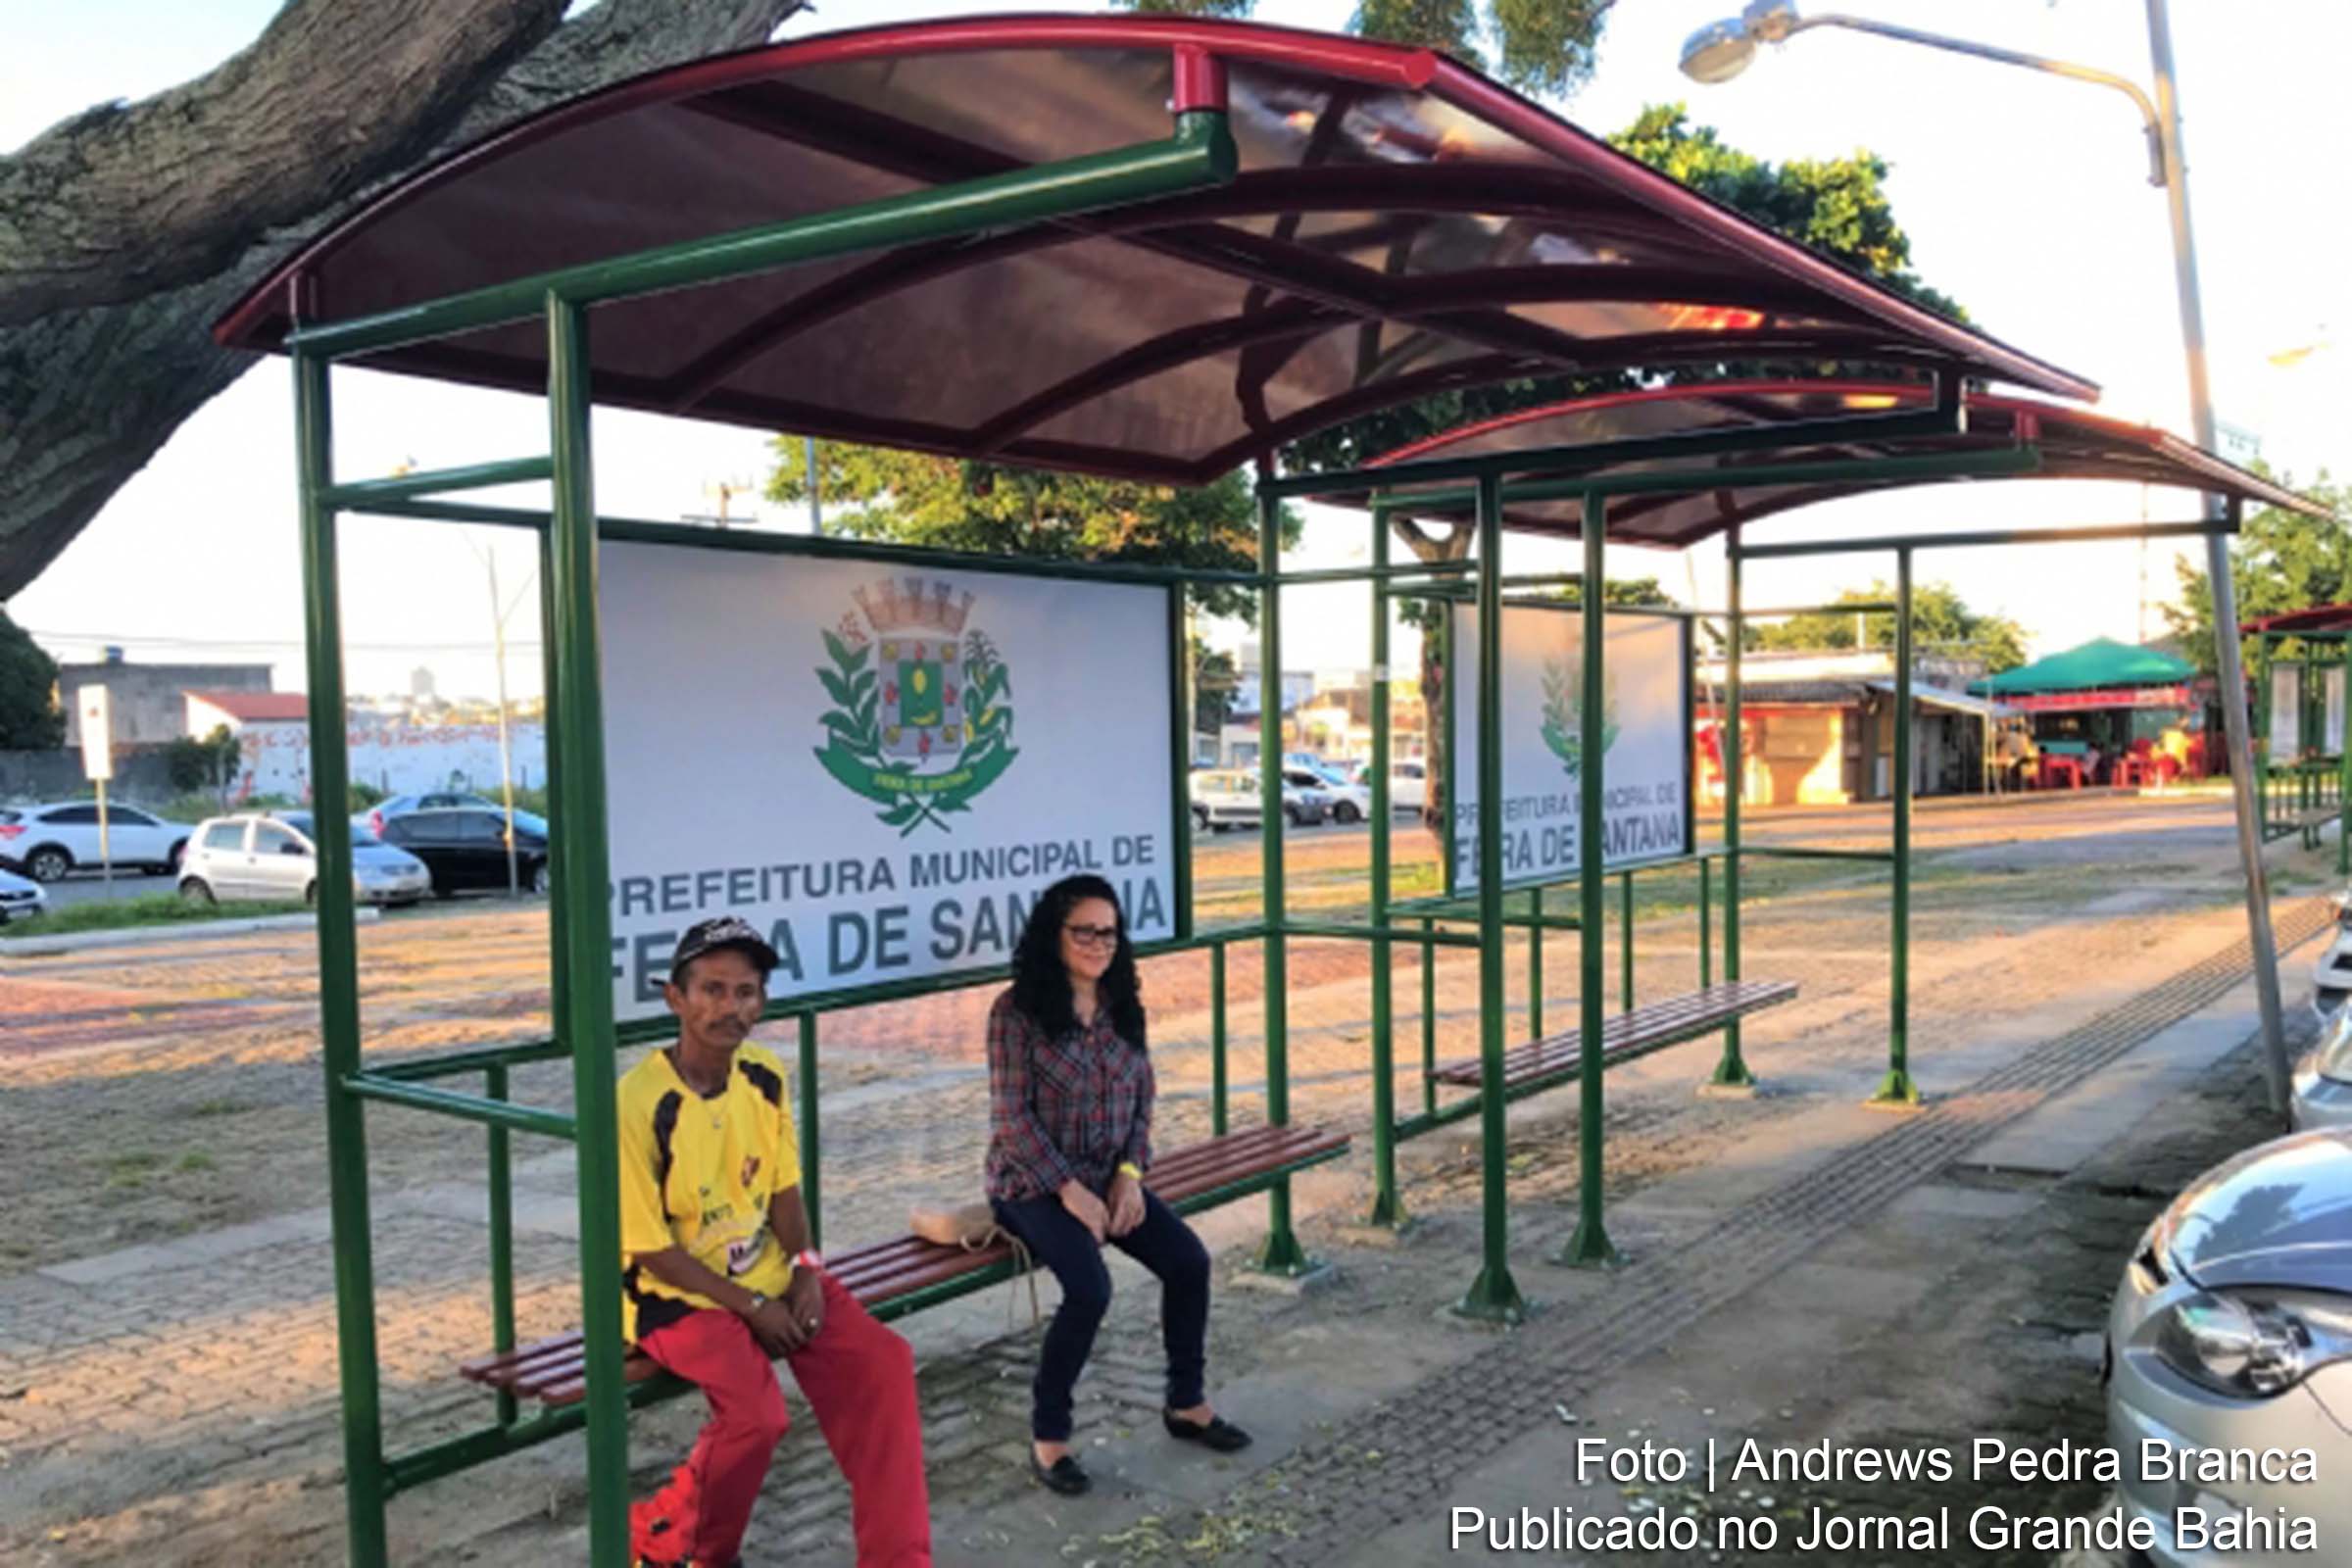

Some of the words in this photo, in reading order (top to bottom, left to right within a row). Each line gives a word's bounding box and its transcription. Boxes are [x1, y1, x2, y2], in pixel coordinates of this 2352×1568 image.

[609, 857, 895, 916] REFEITURA
[909, 840, 1102, 888] MUNICIPAL
[1112, 834, 1154, 867] DE
[1542, 825, 1575, 866] DE
[1602, 812, 1681, 856] ANTANA
[827, 905, 909, 977] DE
